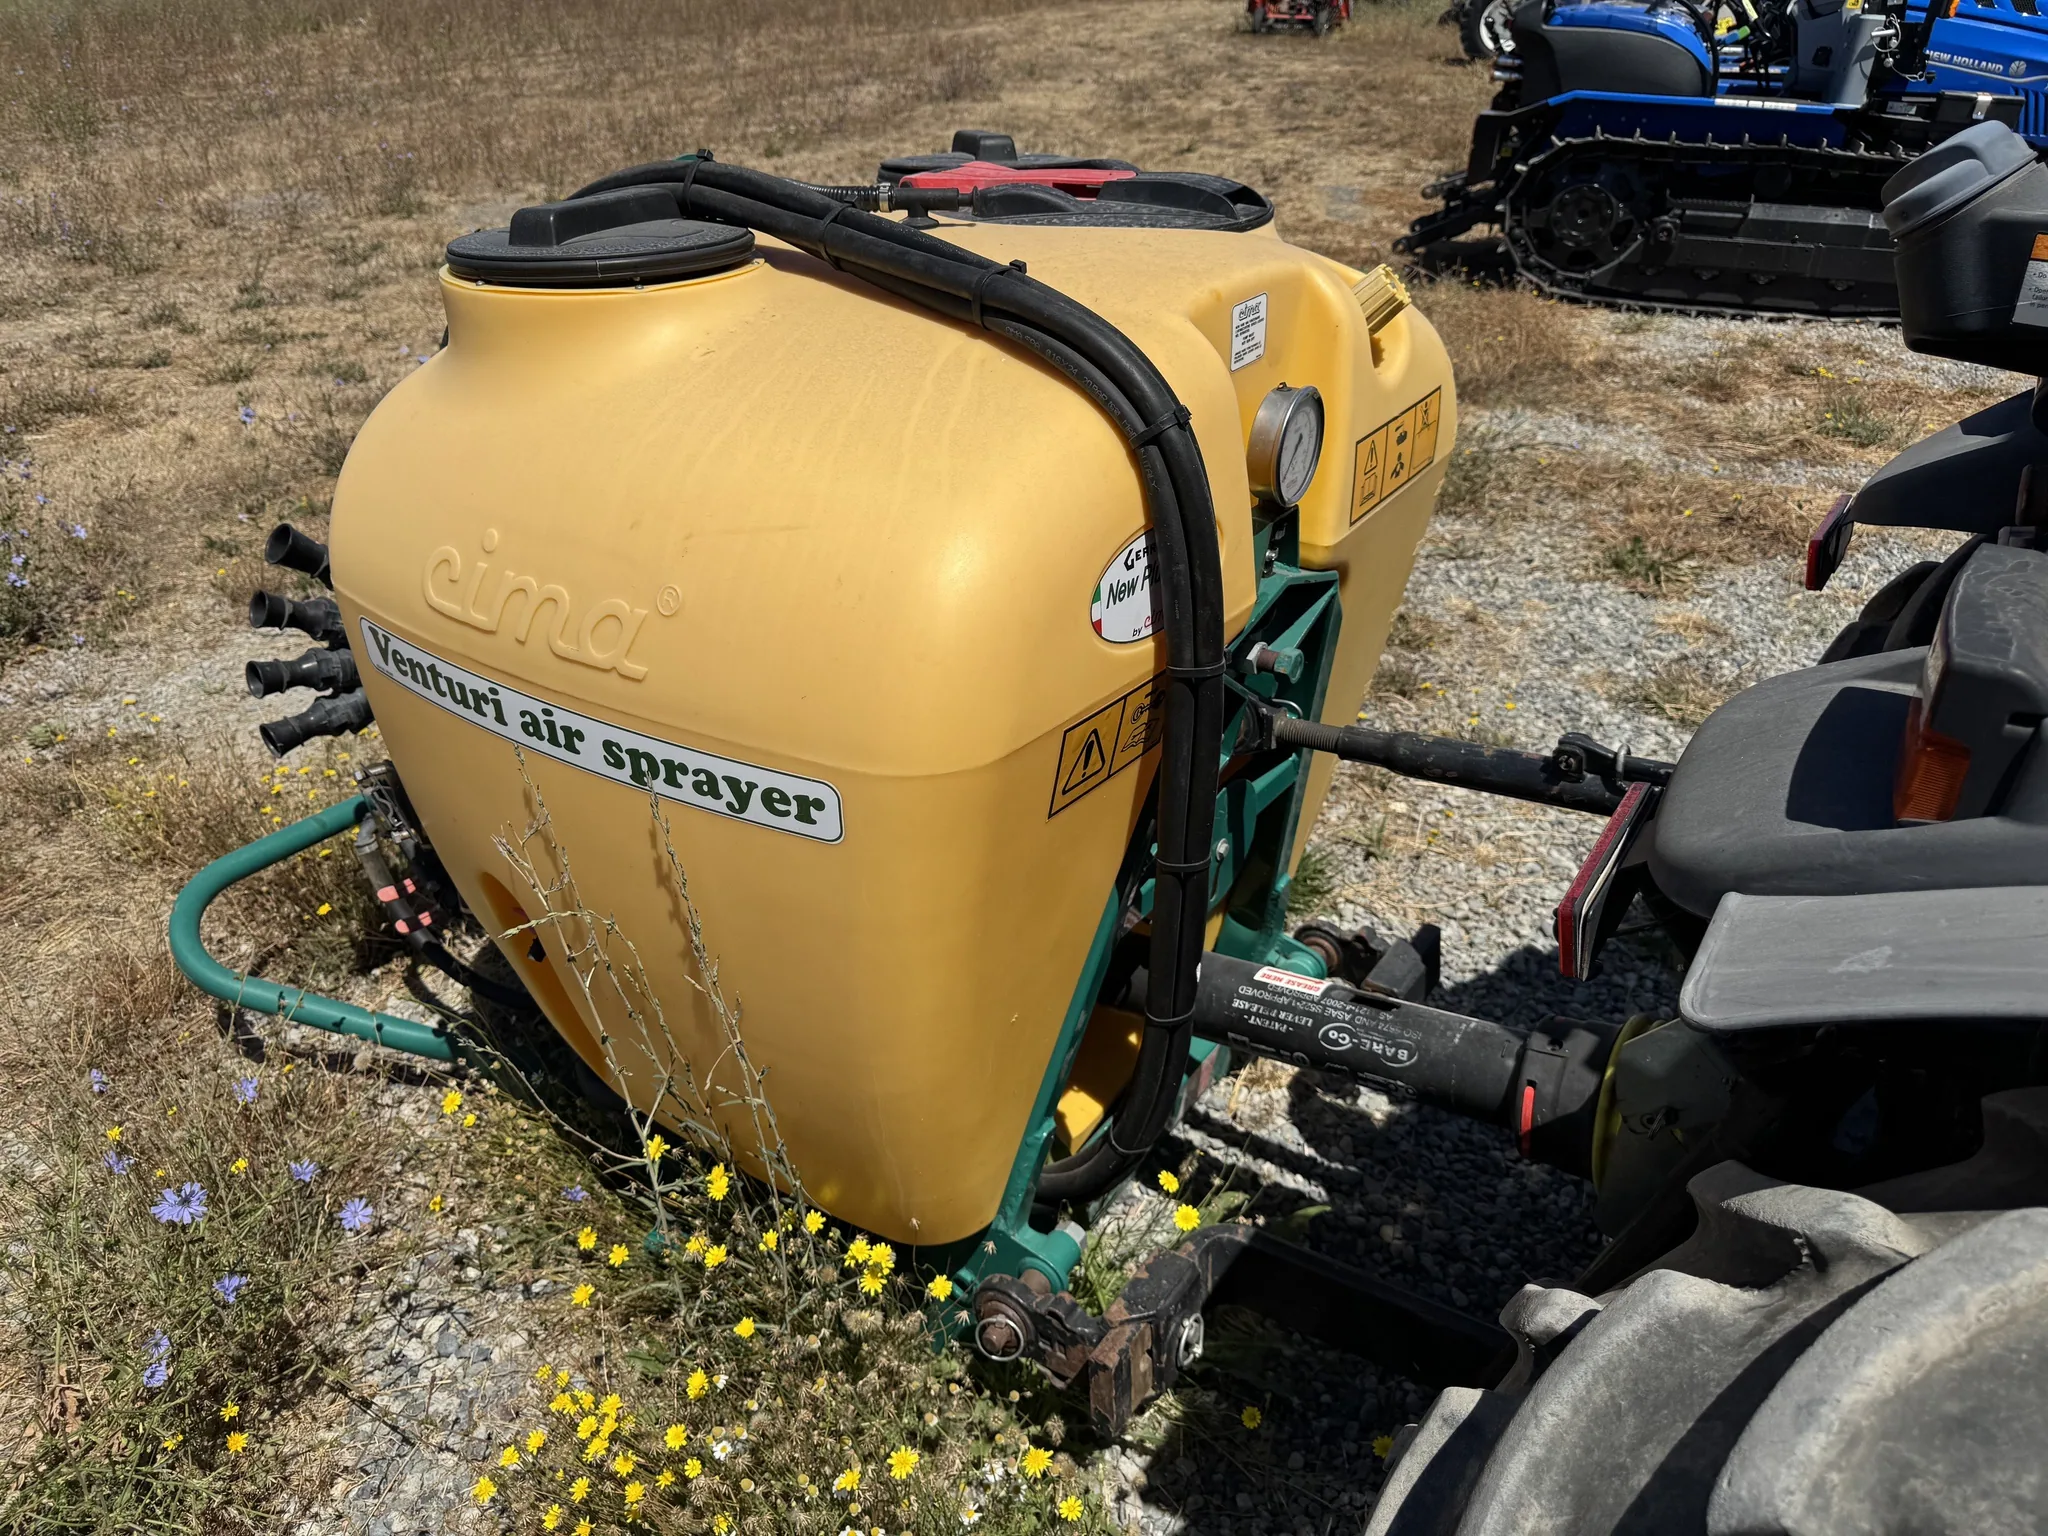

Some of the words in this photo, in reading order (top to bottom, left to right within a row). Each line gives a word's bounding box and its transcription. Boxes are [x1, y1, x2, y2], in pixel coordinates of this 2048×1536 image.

[1925, 49, 1951, 63] NEW
[1952, 54, 2003, 73] HOLLAND
[1106, 575, 1139, 609] New
[1141, 563, 1161, 591] Plu
[422, 527, 650, 681] cima
[1132, 626, 1143, 637] by
[369, 624, 508, 727] Venturi
[520, 706, 585, 755] air
[602, 737, 825, 826] sprayer
[1238, 985, 1290, 1003] APPROVED
[1284, 978, 1320, 992] GREASE
[1278, 1009, 1313, 1027] LEVER
[1323, 1006, 1351, 1021] ASAE
